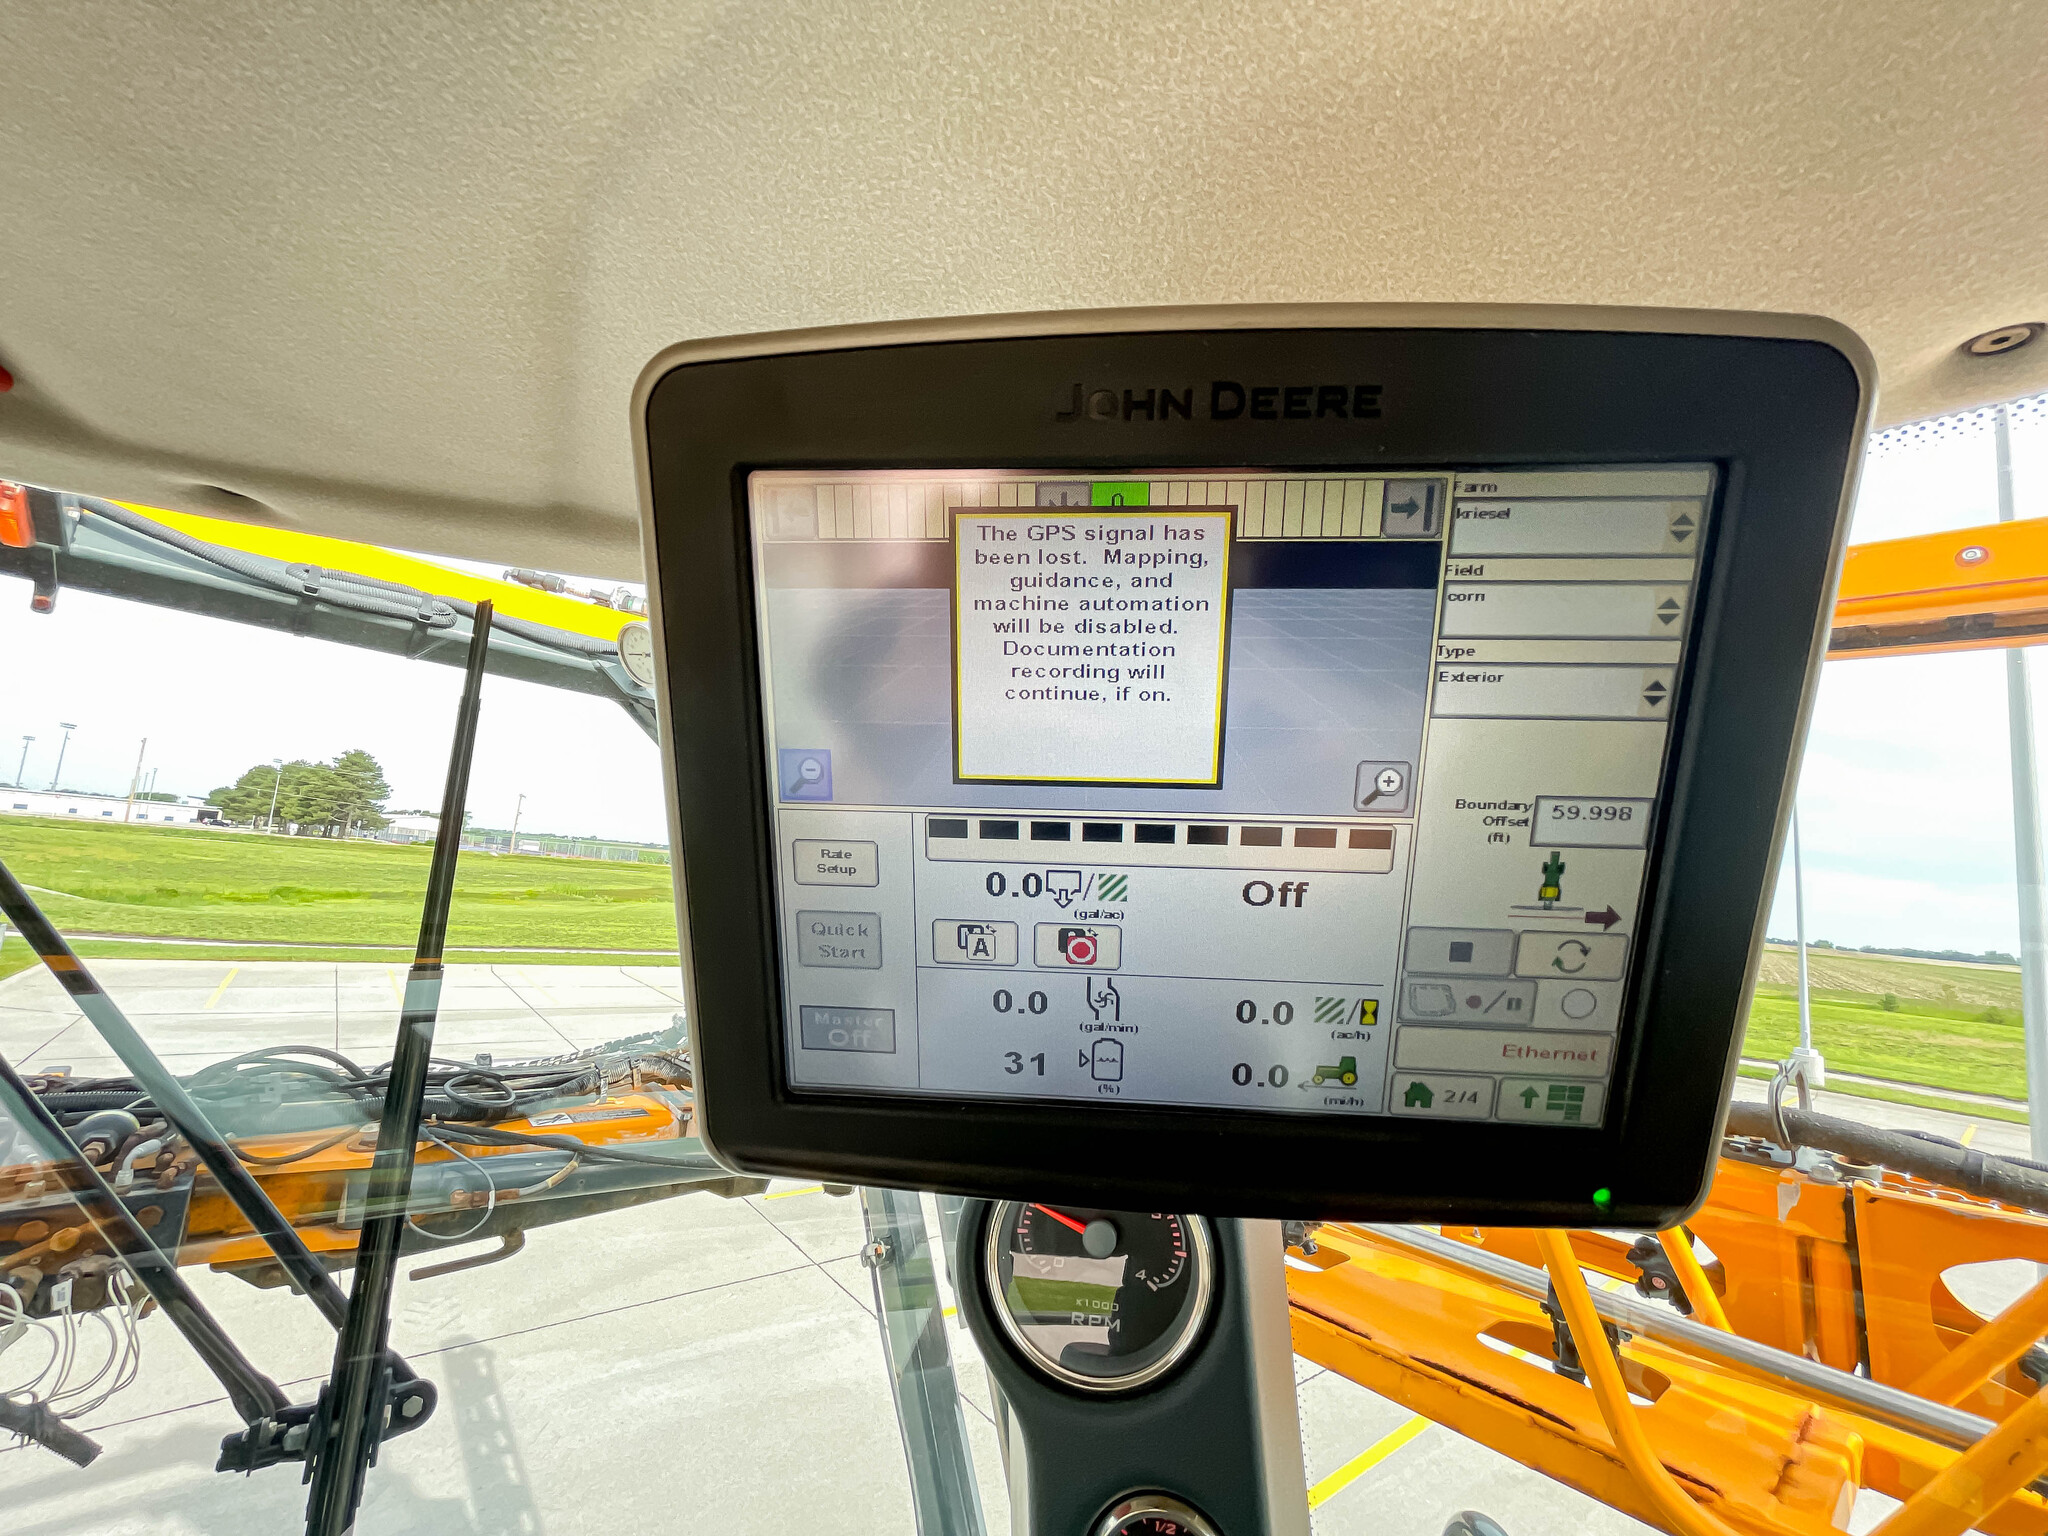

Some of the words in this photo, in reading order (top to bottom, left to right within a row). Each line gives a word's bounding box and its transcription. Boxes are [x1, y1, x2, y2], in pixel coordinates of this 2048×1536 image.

[1055, 383, 1193, 422] JOHN
[1211, 381, 1383, 420] DEERE
[1456, 508, 1510, 520] kriesel
[977, 525, 1017, 542] The
[1027, 525, 1076, 542] GPS
[1085, 525, 1154, 545] signal
[1164, 525, 1205, 541] has
[975, 549, 1030, 565] been
[1038, 549, 1087, 565] lost.
[1104, 550, 1209, 568] Mapping,
[1445, 565, 1484, 577] Field
[1010, 573, 1121, 592] guidance,
[1131, 573, 1173, 588] and
[974, 596, 1069, 611] machine
[1079, 597, 1209, 612] automation
[1448, 592, 1485, 602] corn
[993, 619, 1030, 634] will
[1040, 619, 1065, 634] be
[1074, 619, 1177, 635] disabled.
[1003, 641, 1176, 657] Documentation
[1437, 645, 1475, 659] Type
[1011, 663, 1120, 682] recording
[1128, 665, 1165, 679] will
[1439, 671, 1504, 683] Exterior
[1005, 686, 1107, 703] continue,
[1116, 687, 1131, 701] if
[1139, 689, 1170, 701] on.
[1455, 799, 1534, 814] Boundary
[1552, 805, 1633, 822] 59.998
[1483, 816, 1530, 828] Offset
[1487, 832, 1510, 844] (ft)
[821, 849, 852, 859] Rate
[817, 863, 857, 876] Setup
[986, 871, 1042, 898] 0.0
[1242, 880, 1310, 907] Off
[1074, 908, 1125, 921] (gal/ac)
[811, 921, 869, 938] Quick
[818, 944, 866, 959] Start
[993, 989, 1048, 1015] 0.0
[814, 1011, 885, 1028] Master
[1236, 999, 1294, 1025] 0.0
[1079, 1022, 1139, 1034] (gal/min)
[1331, 1030, 1370, 1042] (ac/h)
[828, 1029, 872, 1047] Off
[1502, 1044, 1599, 1061] Ethernet
[1004, 1051, 1046, 1076] 31
[1232, 1062, 1289, 1088] 0.0
[1445, 1089, 1478, 1105] 2/4
[1135, 1269, 1147, 1281] 4
[1071, 1311, 1121, 1333] RPM
[1155, 1521, 1176, 1534] 1/2
